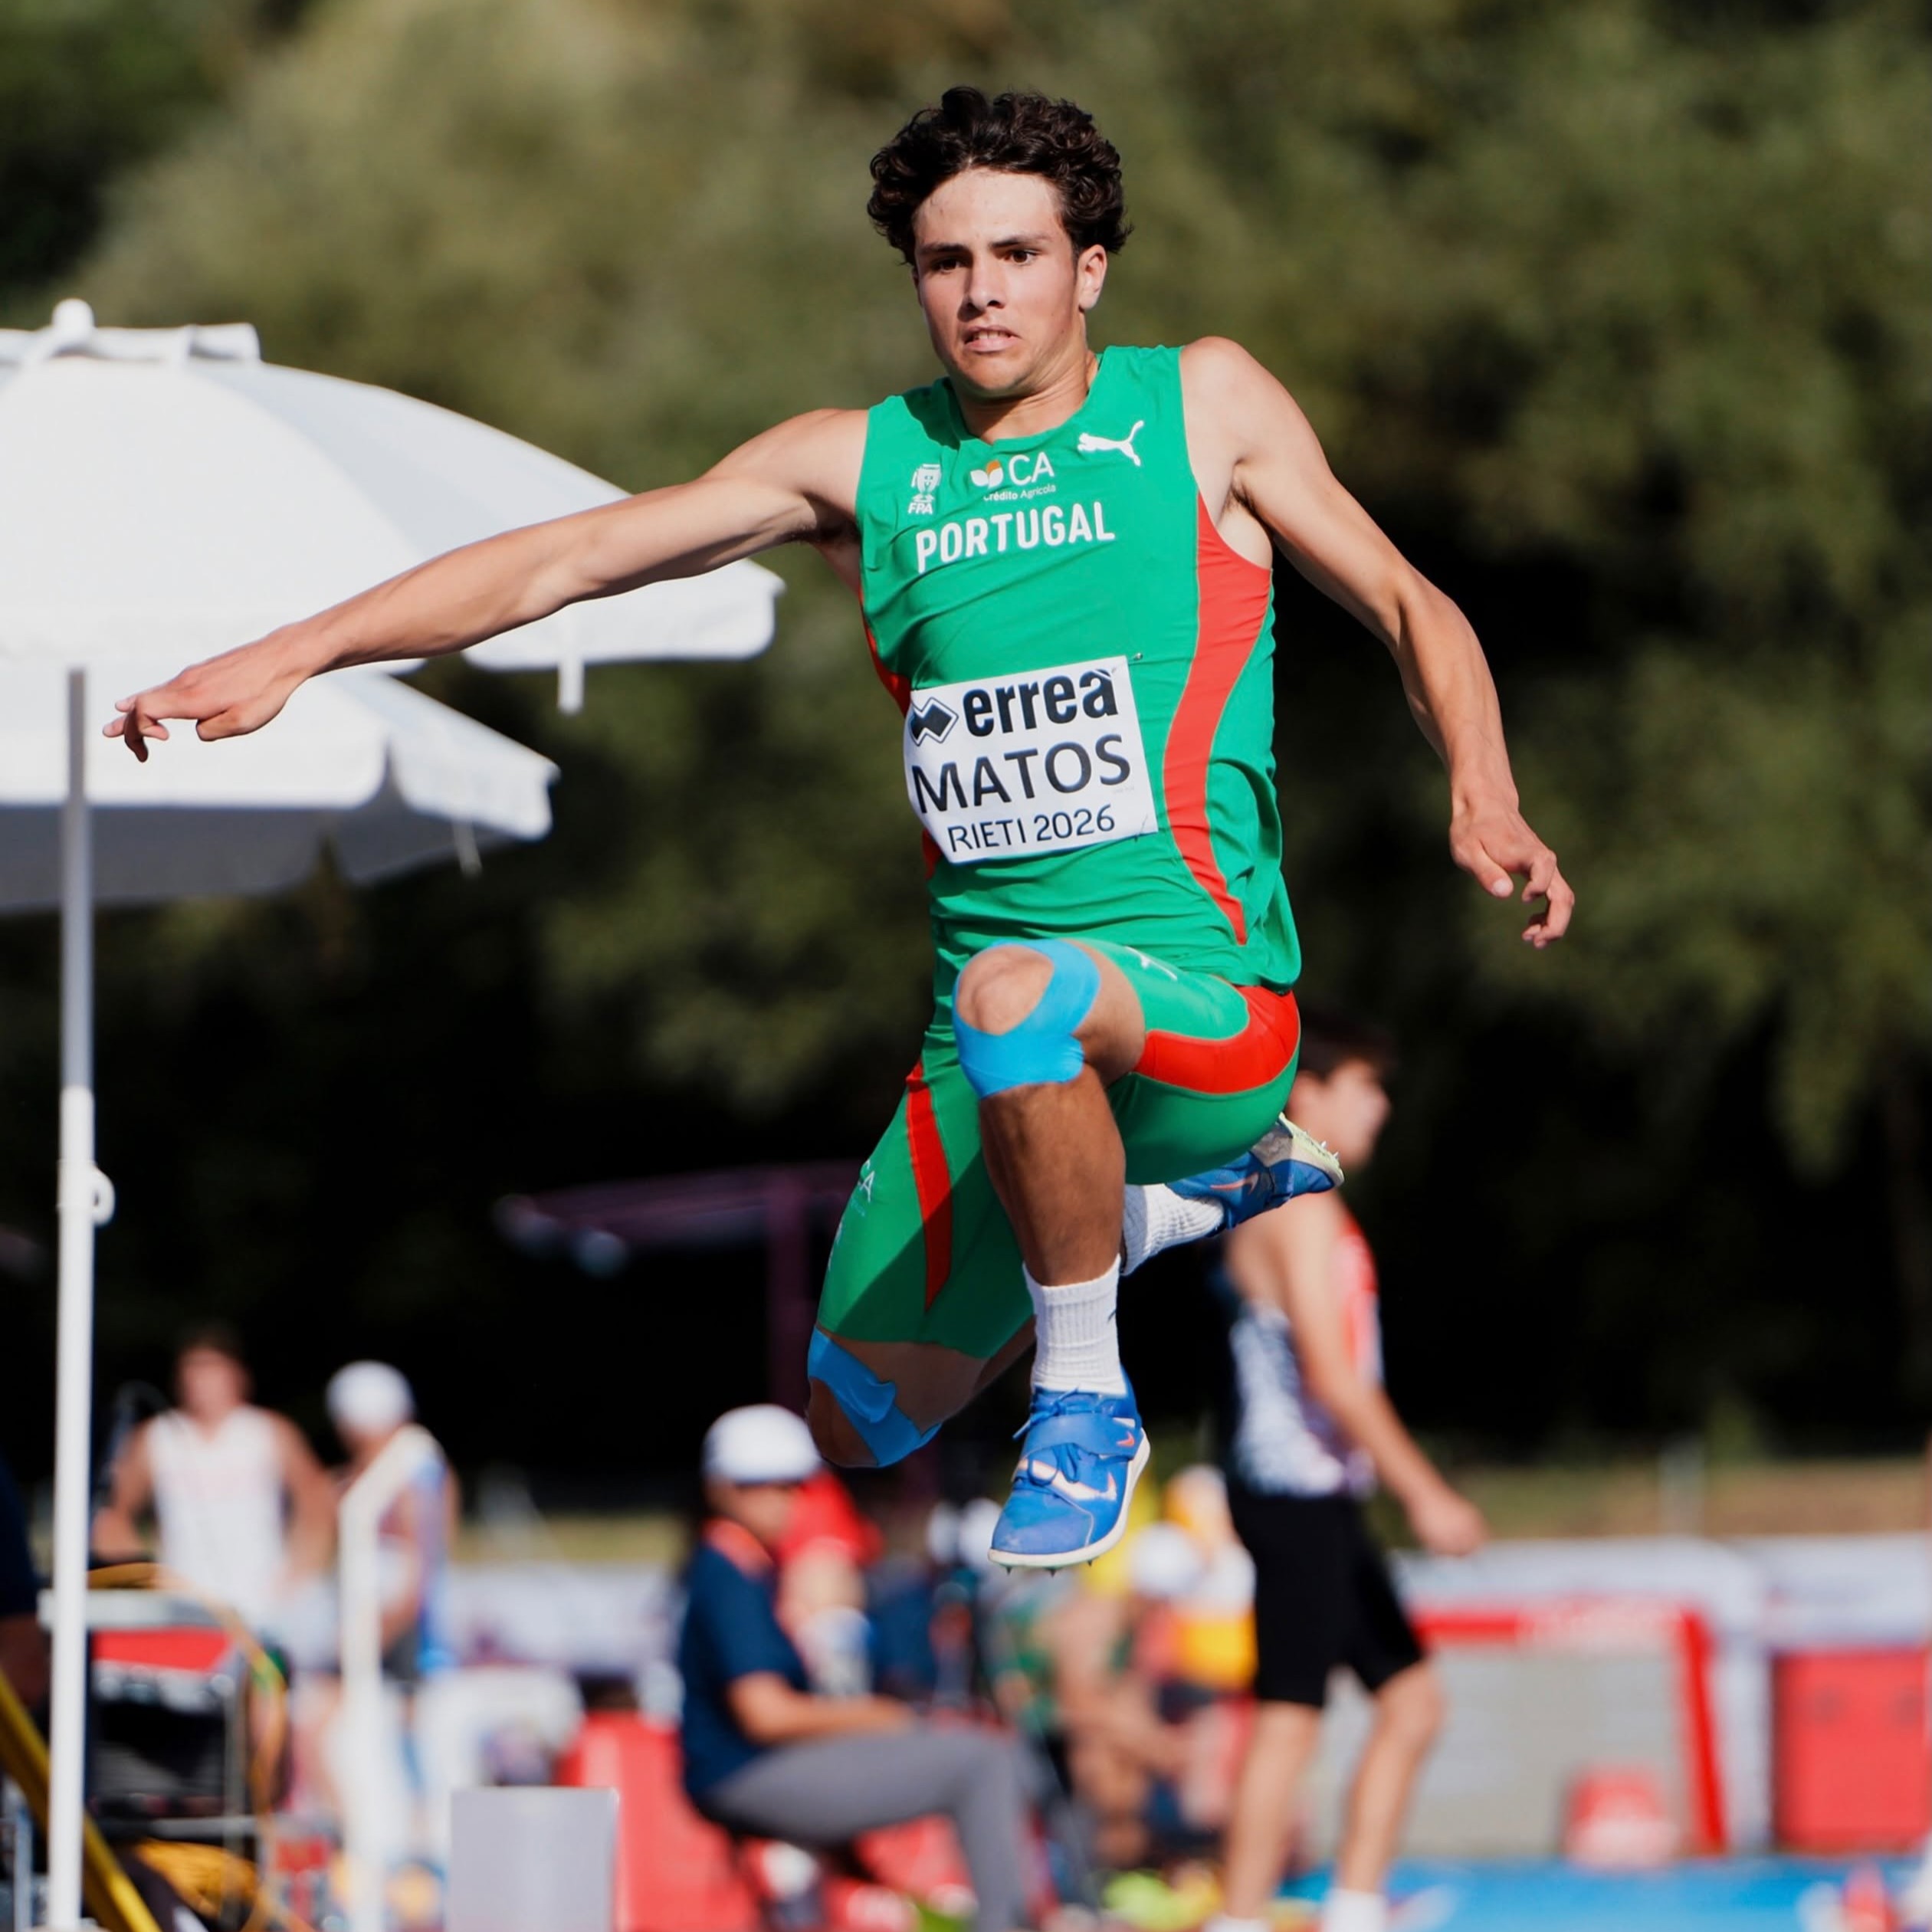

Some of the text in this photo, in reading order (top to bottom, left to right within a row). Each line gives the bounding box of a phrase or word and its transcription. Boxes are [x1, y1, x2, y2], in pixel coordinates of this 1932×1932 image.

[1009, 451, 1055, 486] CA
[907, 502, 933, 515] FPA
[916, 500, 1116, 574] PORTUGAL
[911, 733, 1131, 815] MATOS
[947, 804, 1116, 853] RIETI 2026
